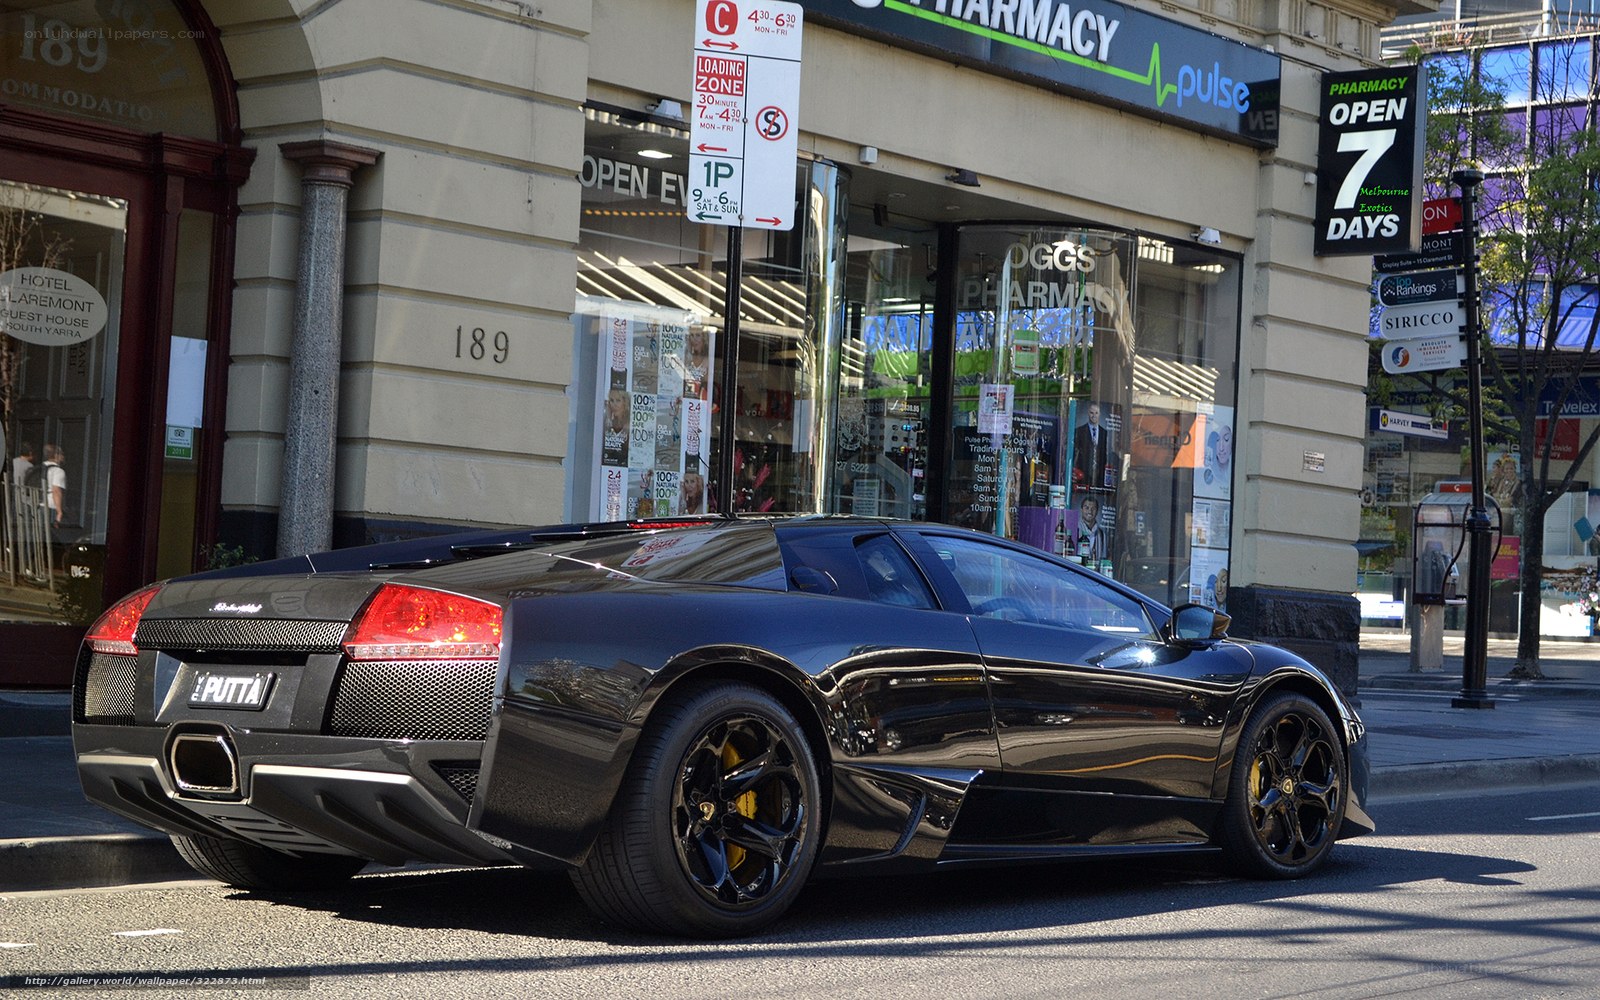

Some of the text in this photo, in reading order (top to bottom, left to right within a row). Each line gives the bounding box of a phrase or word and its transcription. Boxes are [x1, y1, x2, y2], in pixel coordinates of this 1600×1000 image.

[714, 3, 730, 33] C
[19, 12, 109, 73] 189
[698, 58, 743, 77] LOADING
[696, 76, 743, 94] ZONE
[1177, 62, 1250, 114] pulse
[1329, 77, 1408, 96] PHARMACY
[699, 94, 715, 105] 30
[1329, 97, 1407, 126] OPEN
[703, 160, 734, 187] 1P
[1333, 128, 1396, 209] 7
[578, 154, 649, 199] OPEN
[696, 202, 739, 214] SAT & SUN
[1326, 214, 1400, 241] DAYS
[1006, 243, 1096, 273] OGGS
[20, 273, 73, 292] HOTEL
[1396, 276, 1412, 287] Top
[1396, 283, 1437, 296] Rankings
[0, 308, 89, 328] GUEST HOUSE
[613, 318, 627, 327] 2.4
[1385, 312, 1454, 331] SIRICCO
[6, 322, 82, 338] SOUTH YARRA
[661, 333, 683, 341] NATURAL
[456, 325, 509, 363] 189
[661, 339, 683, 350] 100%
[632, 394, 655, 406] 100%
[688, 402, 701, 411] 2.4
[632, 411, 655, 421] 100%
[1390, 418, 1410, 427] HARVEY
[631, 429, 654, 442] 100%
[969, 444, 998, 454] Trading
[977, 454, 995, 463] Mon
[850, 463, 869, 473] 5222
[974, 464, 992, 473] 8am
[607, 470, 622, 480] 2.4
[656, 472, 679, 482] 100%
[655, 481, 678, 489] NATURAL
[973, 483, 991, 492] 9am
[655, 488, 678, 499] 100%
[970, 503, 992, 513] 10am
[201, 676, 265, 704] PUTTA
